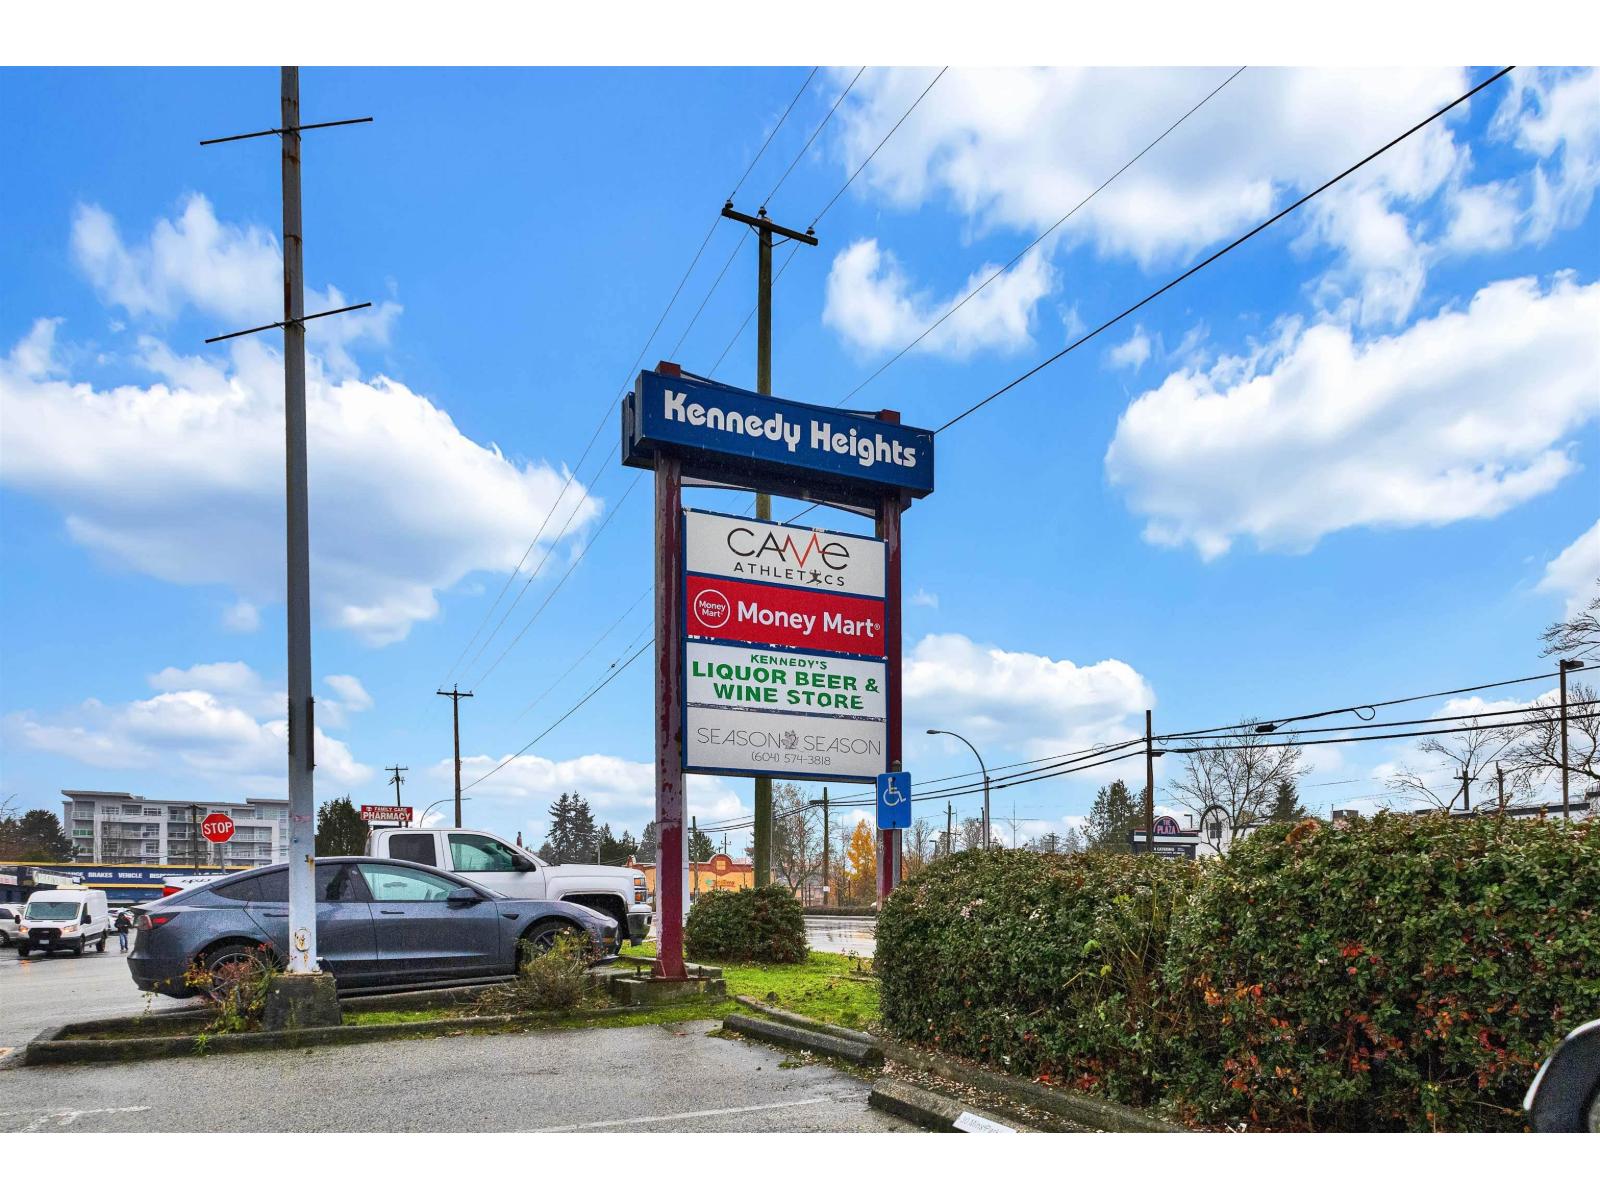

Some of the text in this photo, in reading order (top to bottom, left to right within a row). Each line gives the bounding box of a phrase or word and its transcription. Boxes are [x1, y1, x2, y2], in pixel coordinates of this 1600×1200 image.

[664, 389, 917, 468] Kennedy Heights
[699, 600, 726, 612] Money
[737, 600, 817, 636] Money
[750, 654, 828, 670] KENNEDY'S
[692, 661, 880, 694] LIQUOR BEER &
[713, 683, 864, 710] WINE STORE
[697, 727, 781, 749] SEASON
[803, 735, 881, 755] SEASON
[751, 751, 831, 766] (604) 574-3818
[363, 811, 411, 821] PHARMACY
[203, 823, 233, 835] STOP
[1157, 825, 1176, 835] PLAZA
